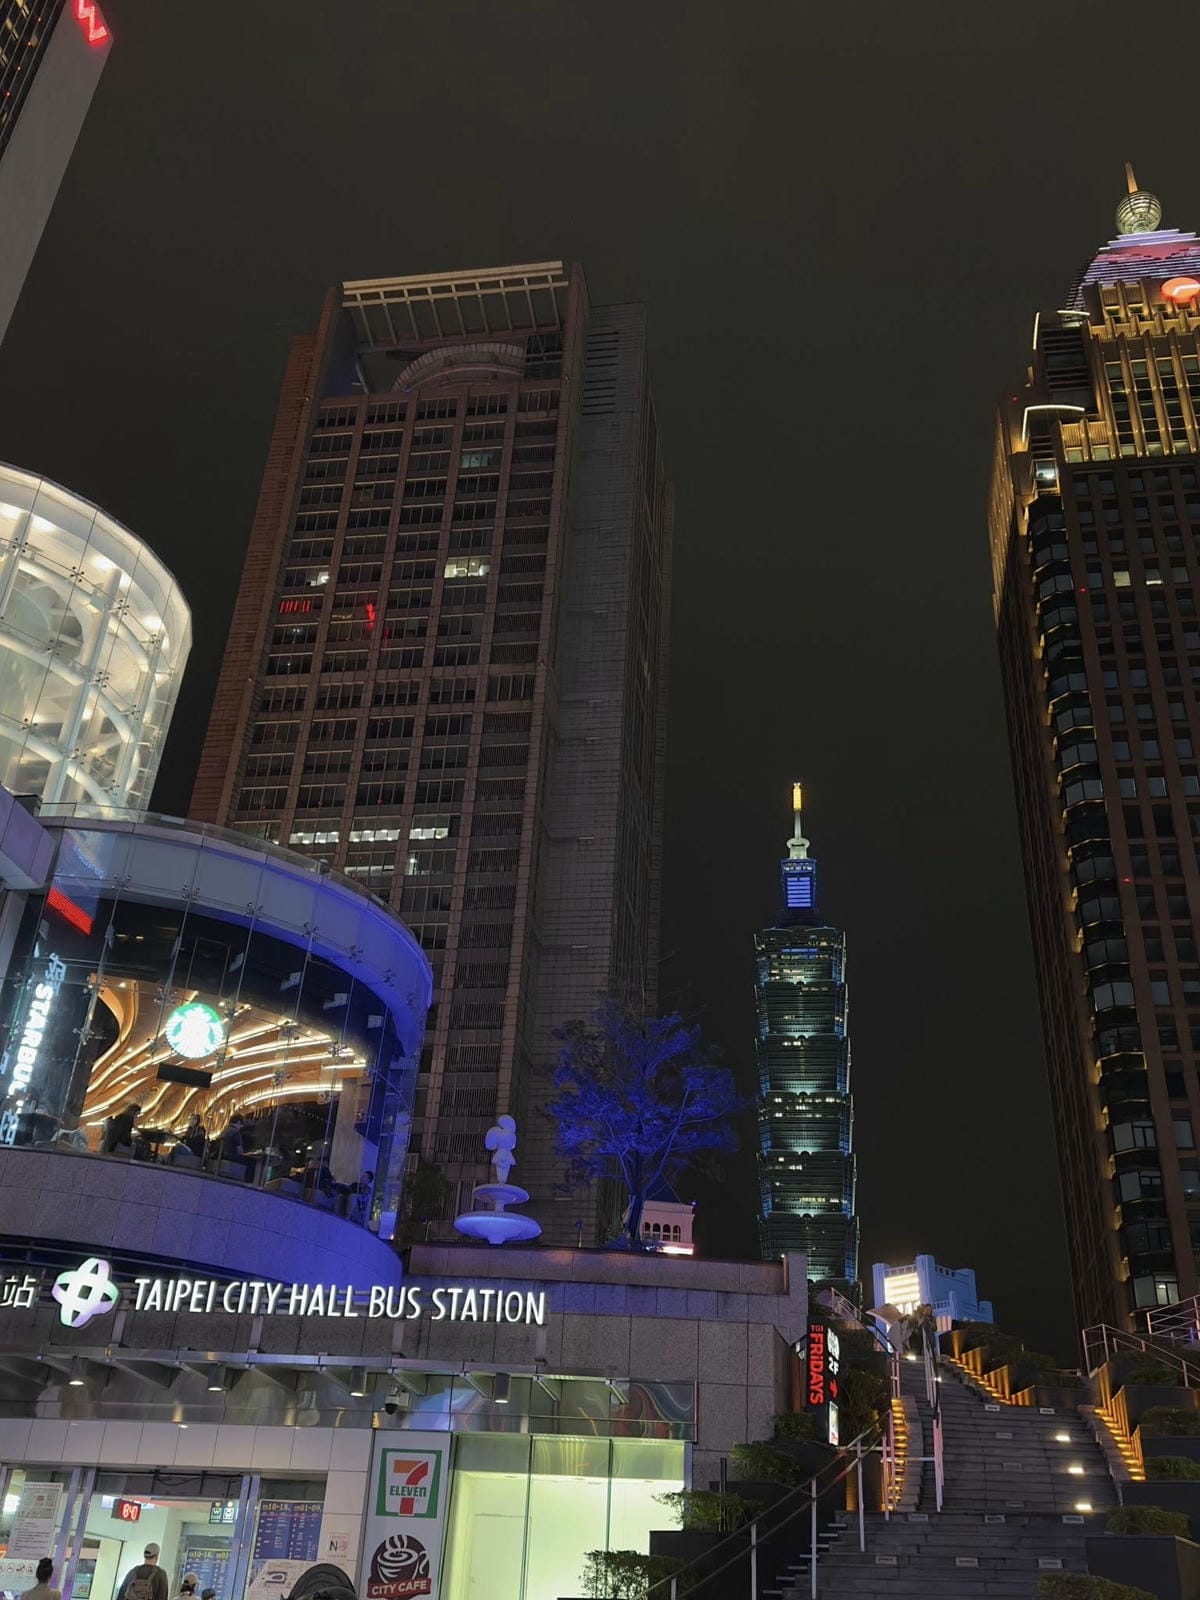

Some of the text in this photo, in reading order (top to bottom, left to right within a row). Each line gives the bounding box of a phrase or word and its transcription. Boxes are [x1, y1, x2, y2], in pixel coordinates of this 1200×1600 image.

[134, 1278, 545, 1325] TAIPEI CITY HALL BUS STATION
[393, 1460, 429, 1515] 7
[371, 1579, 427, 1596] CITY CAFE
